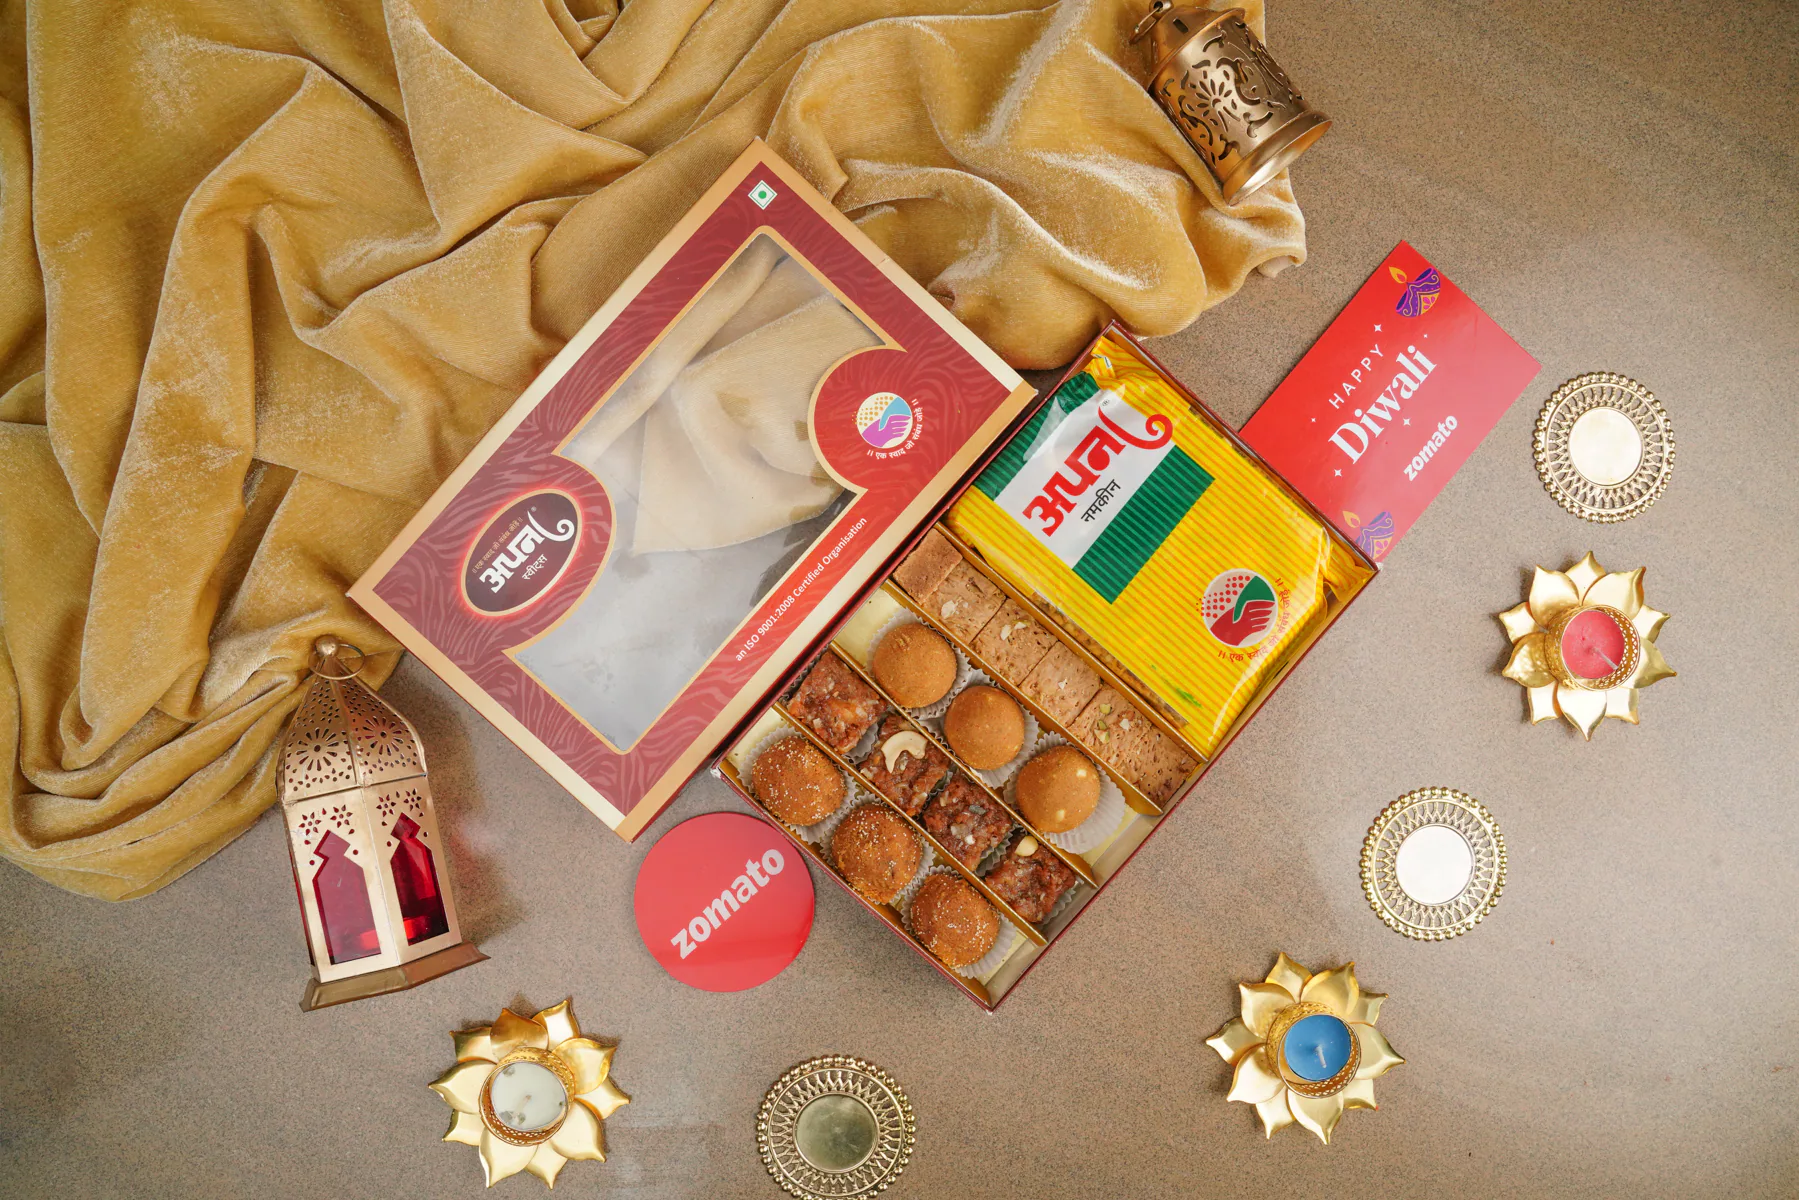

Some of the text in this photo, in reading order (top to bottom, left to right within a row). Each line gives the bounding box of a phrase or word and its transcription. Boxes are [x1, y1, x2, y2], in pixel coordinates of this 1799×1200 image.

[1328, 344, 1384, 409] HAPPY
[1328, 345, 1437, 464] Diwali
[1403, 415, 1458, 481] zomato
[1080, 478, 1121, 523] नमकीन
[522, 553, 548, 581] स्वीट्स
[735, 517, 867, 662] an ISO 9001:2008 Certified Organisation
[1229, 653, 1244, 663] एक
[670, 849, 785, 960] zomato
